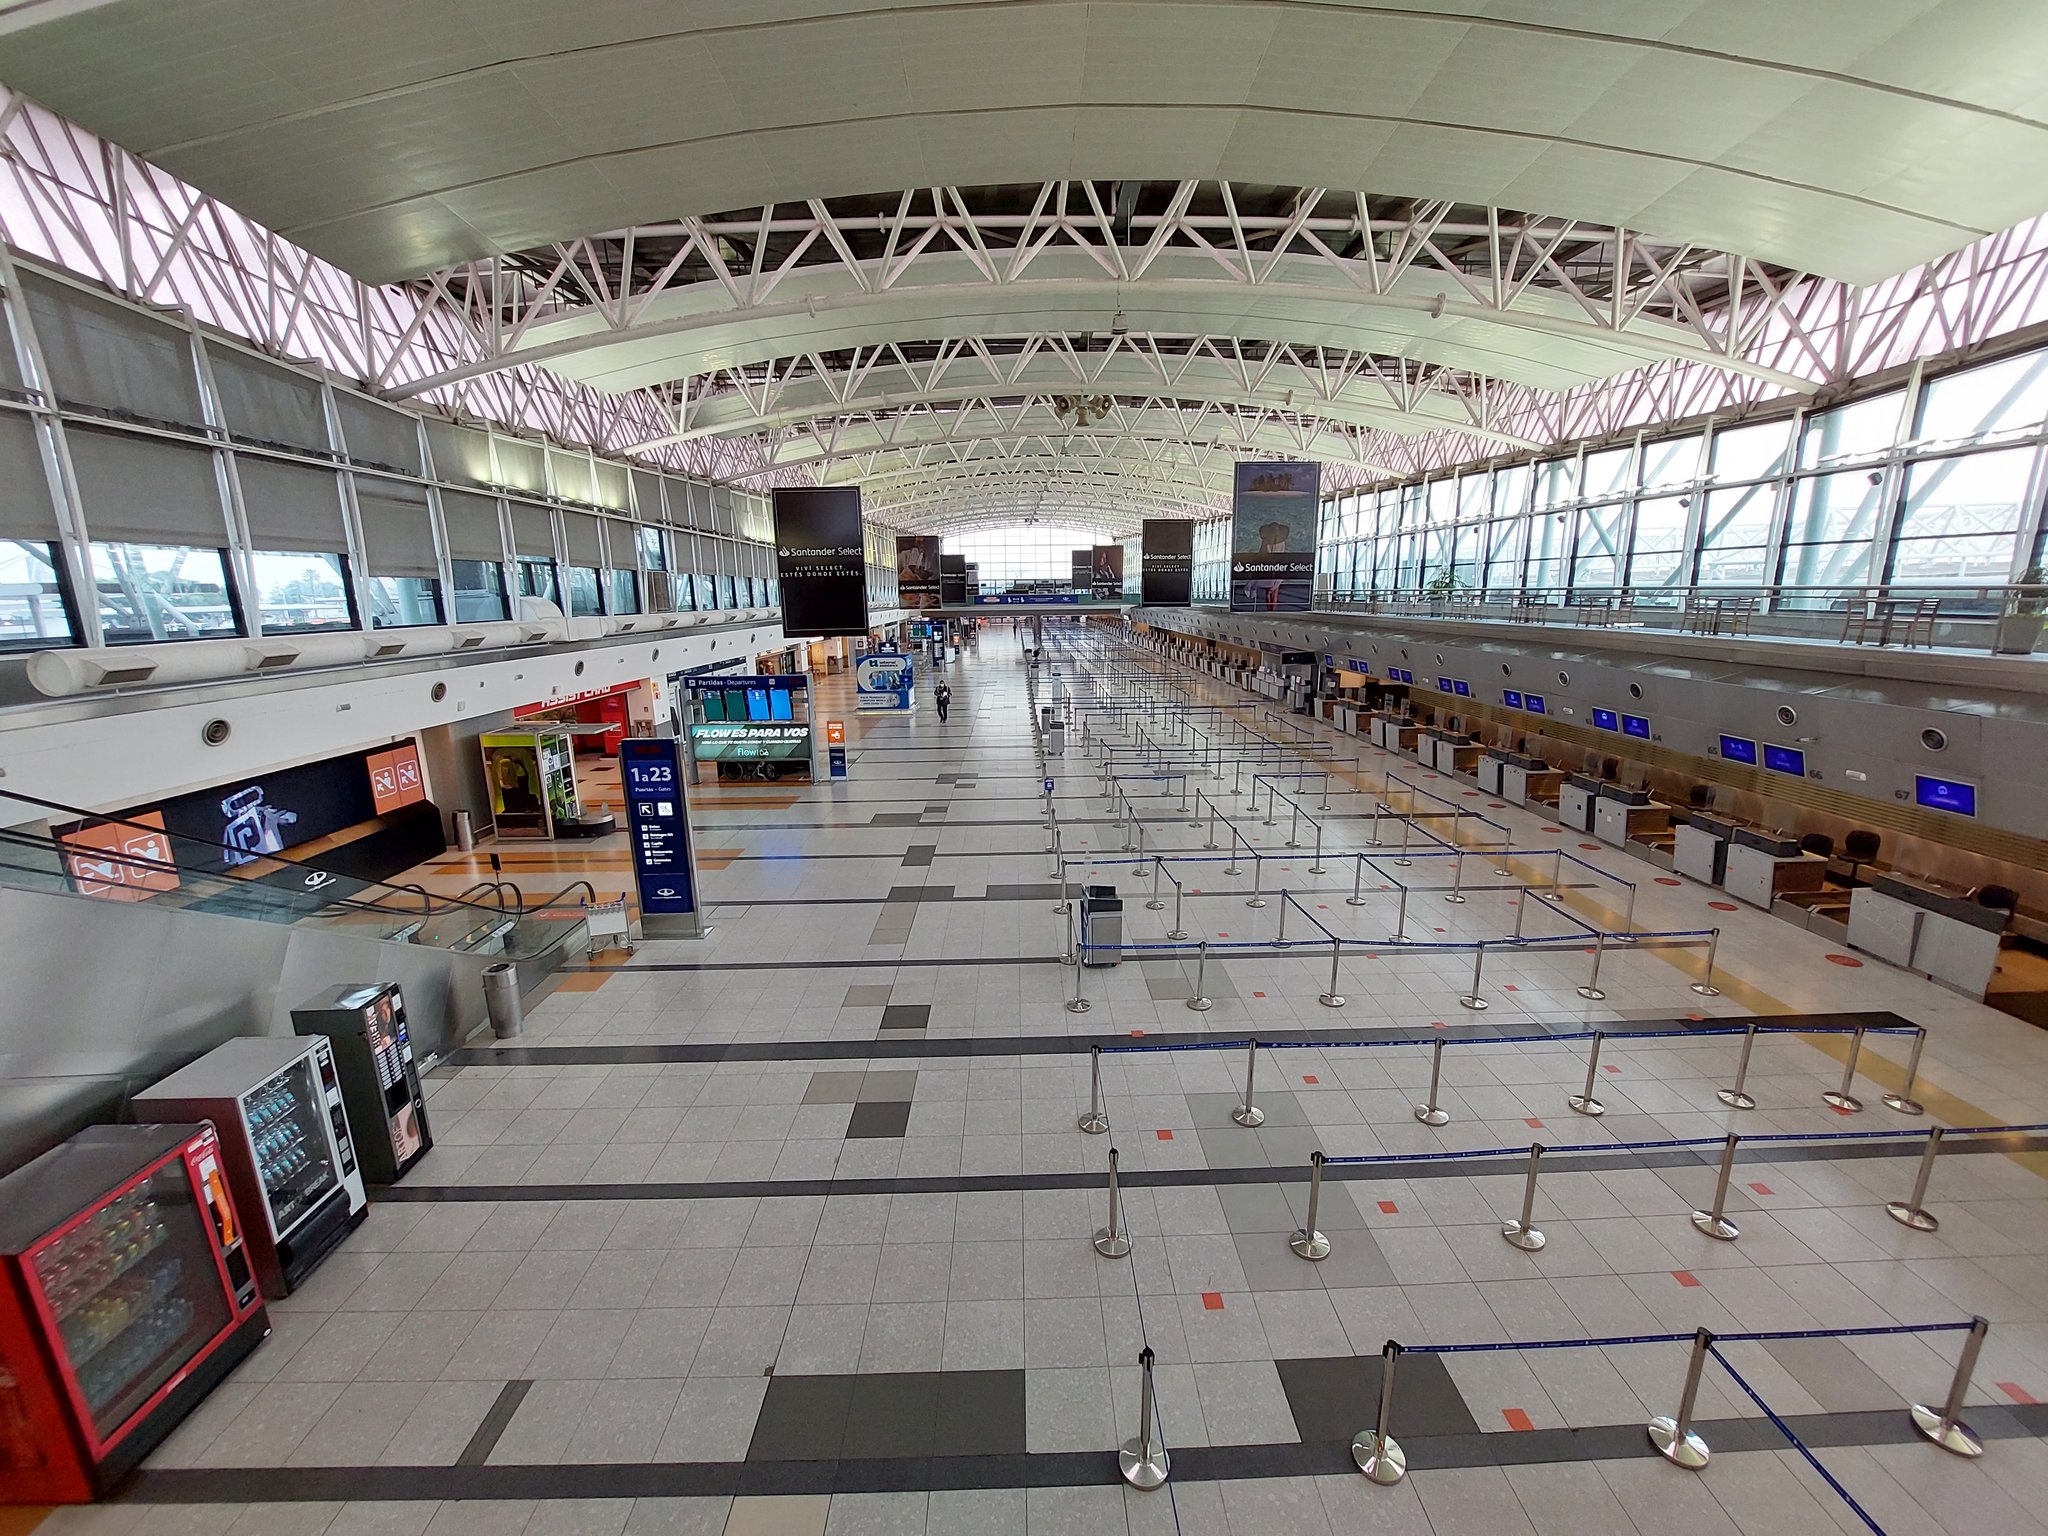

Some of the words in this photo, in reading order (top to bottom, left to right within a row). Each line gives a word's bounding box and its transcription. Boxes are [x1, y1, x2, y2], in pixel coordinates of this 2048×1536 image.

[791, 547, 836, 557] Santander
[837, 546, 863, 556] Select
[1245, 562, 1288, 572] Santander
[1289, 562, 1313, 572] Select
[695, 729, 732, 738] FLOW
[730, 728, 748, 738] ES
[747, 728, 781, 738] PARA
[783, 727, 809, 737] VOS
[737, 747, 757, 757] flow
[630, 767, 640, 783] 1
[641, 773, 649, 783] a
[649, 766, 672, 783] 23
[1894, 789, 1910, 800] 67
